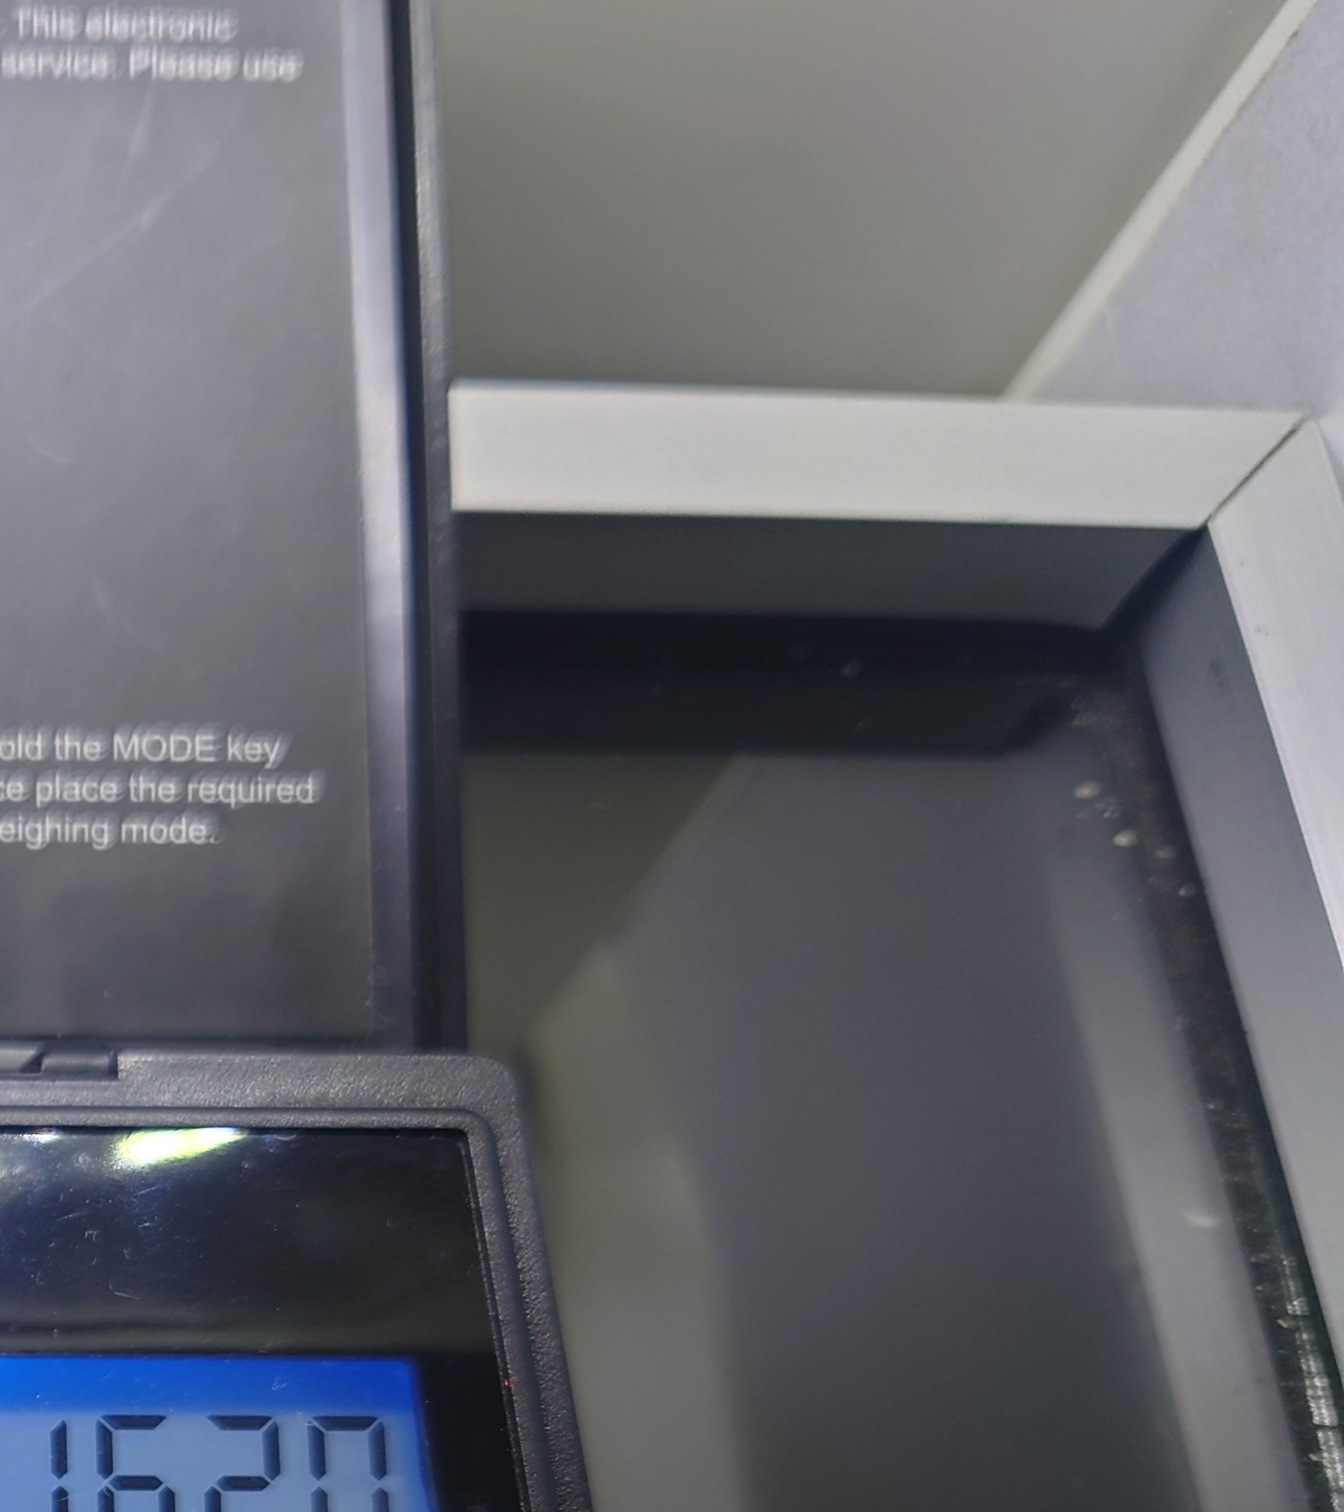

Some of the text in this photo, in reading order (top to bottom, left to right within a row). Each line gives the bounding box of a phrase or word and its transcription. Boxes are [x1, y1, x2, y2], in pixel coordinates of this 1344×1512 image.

[52, 726, 107, 762] the
[110, 727, 224, 762] MODE
[224, 727, 289, 771] key
[34, 768, 120, 810] place
[127, 768, 180, 803] the
[185, 769, 324, 812] required
[118, 811, 224, 845] mode.
